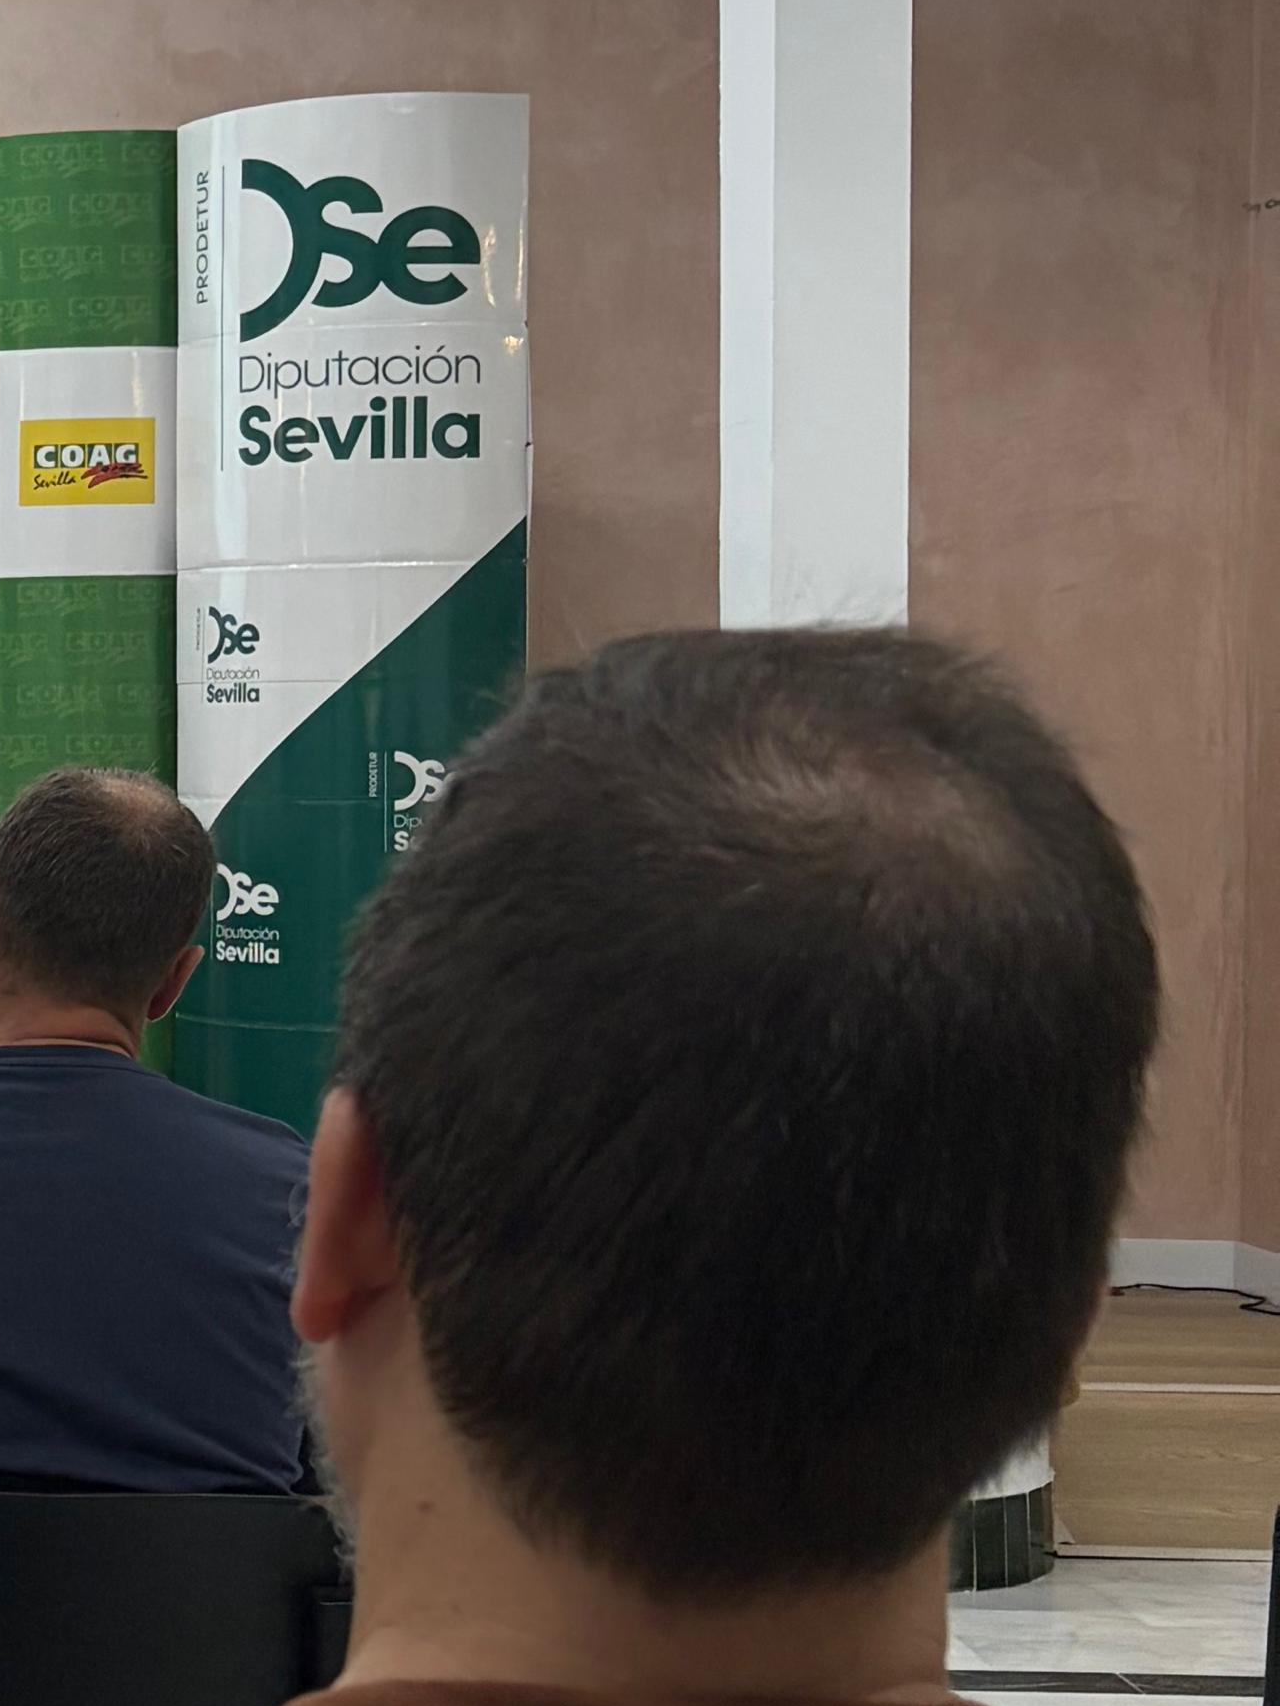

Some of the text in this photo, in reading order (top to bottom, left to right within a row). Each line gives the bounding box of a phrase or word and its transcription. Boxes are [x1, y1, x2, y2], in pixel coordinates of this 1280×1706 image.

[196, 169, 209, 305] PRODETUR
[239, 344, 482, 399] Diputación
[238, 395, 482, 467] Sevilla
[34, 443, 139, 469] COAG
[33, 470, 77, 491] Sevilla
[206, 682, 260, 703] Sevilla
[215, 924, 280, 941] Diputación
[215, 940, 280, 964] Sevilla
